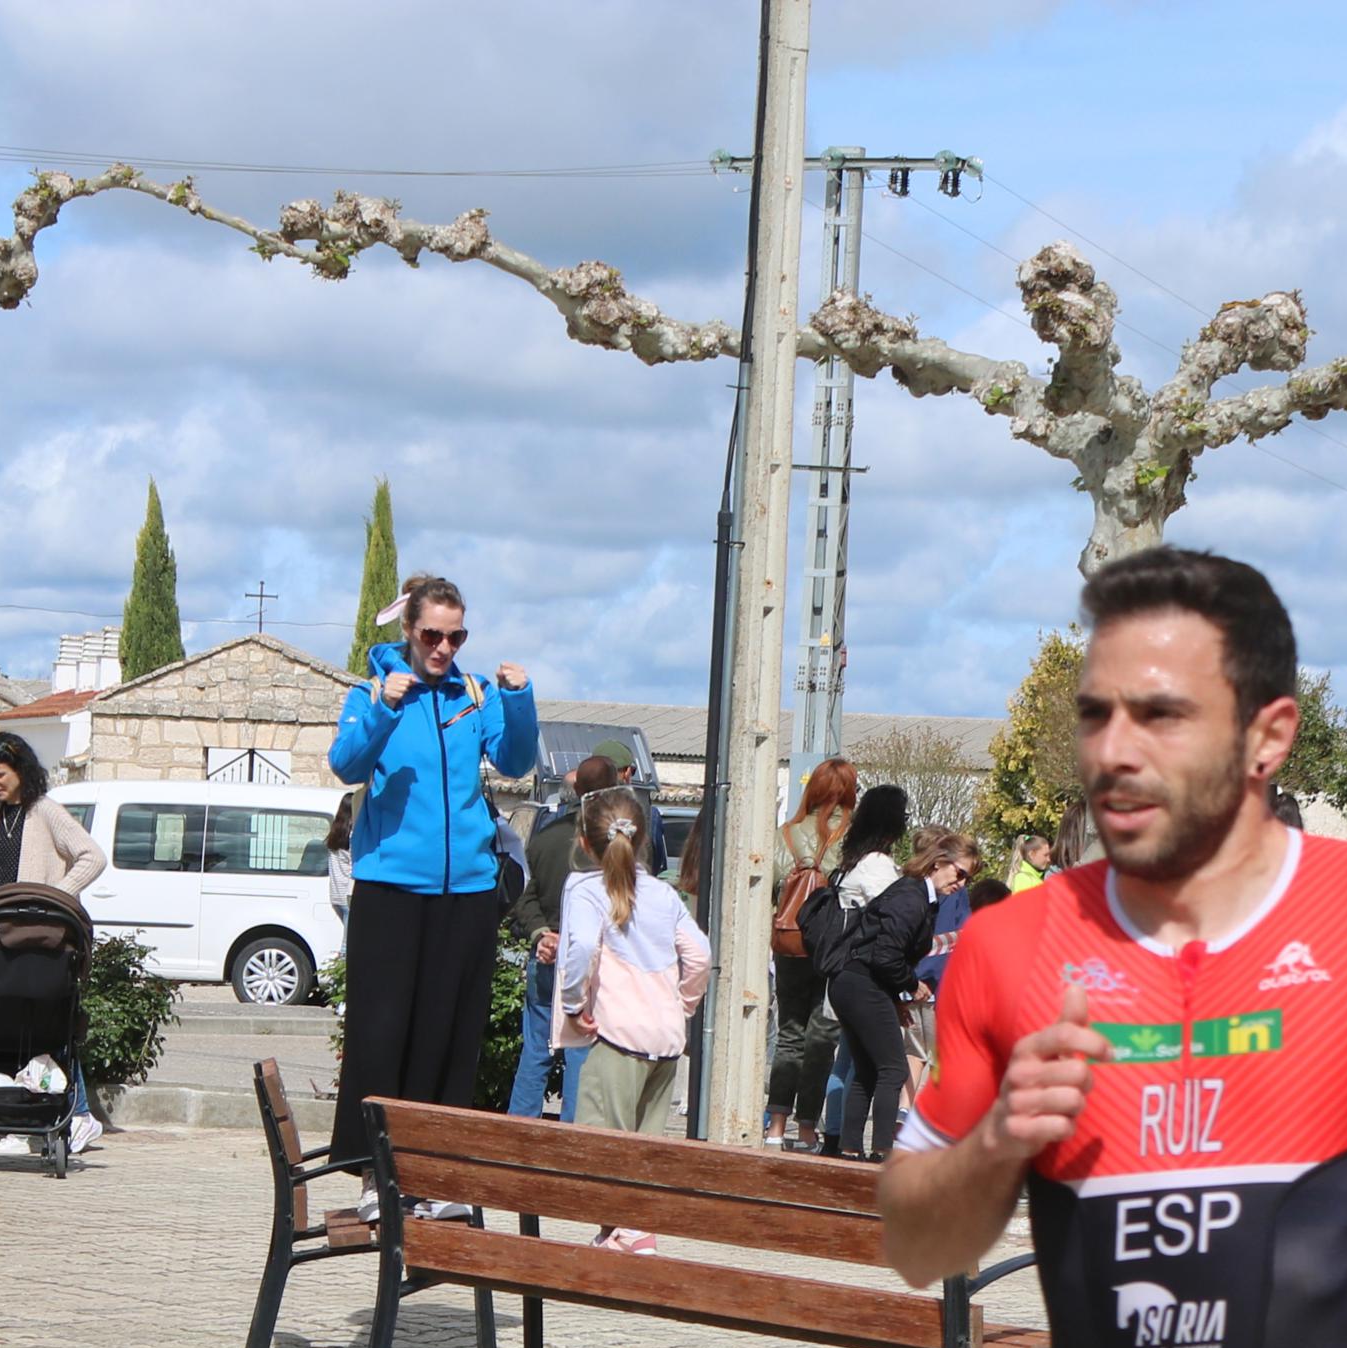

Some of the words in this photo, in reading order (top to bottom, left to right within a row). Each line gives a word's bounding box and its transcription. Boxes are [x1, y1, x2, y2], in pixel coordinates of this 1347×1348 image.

[1228, 1016, 1270, 1055] in
[1140, 1078, 1224, 1156] RUIZ
[1115, 1191, 1241, 1261] ESP
[1141, 1299, 1227, 1345] SORIA
